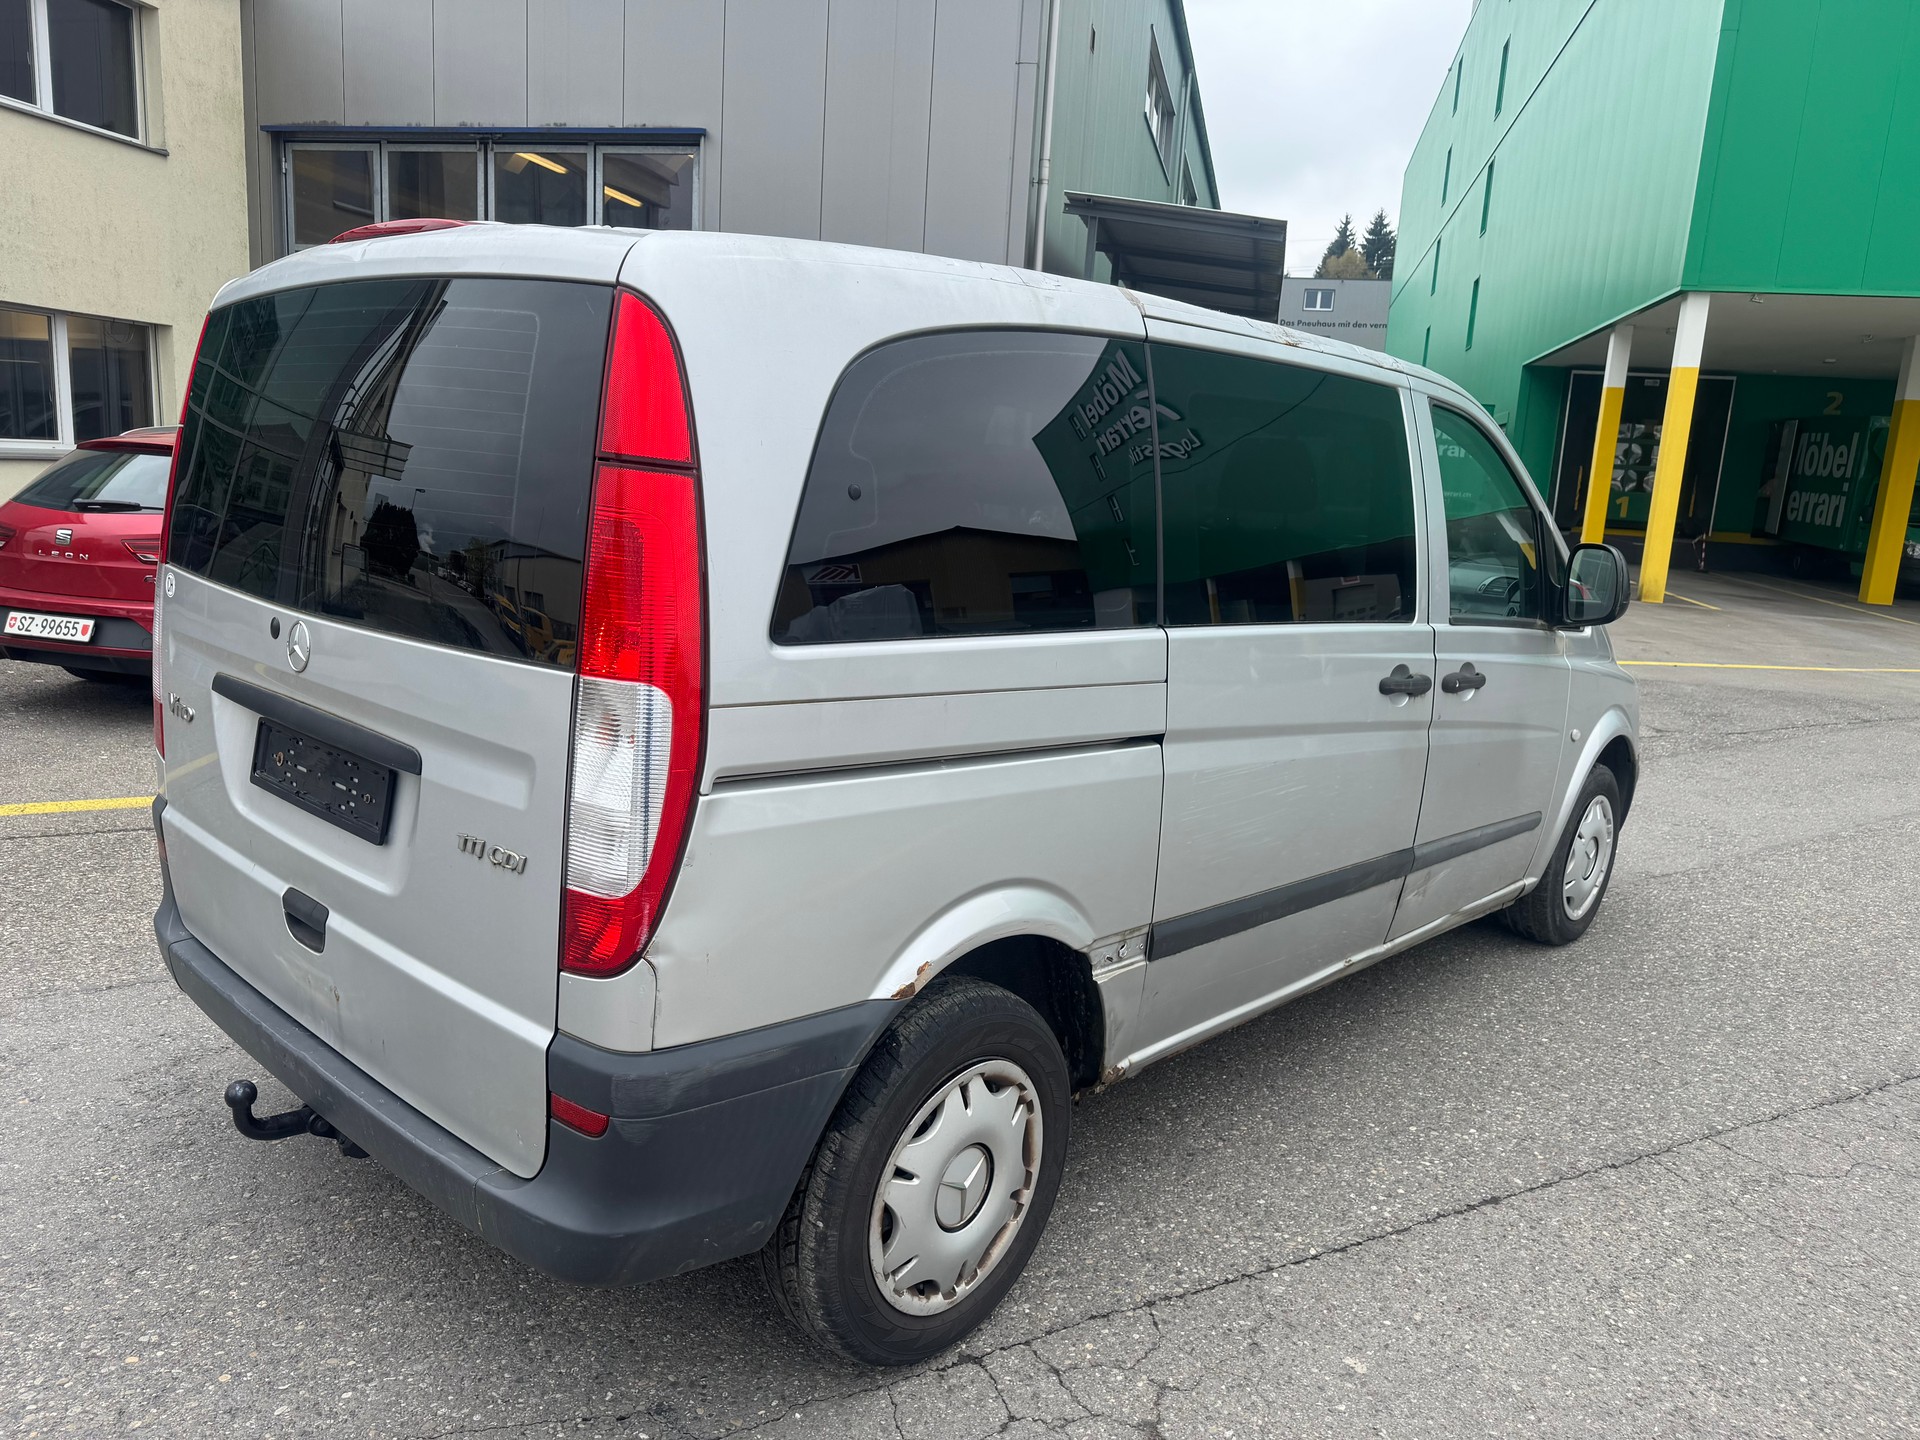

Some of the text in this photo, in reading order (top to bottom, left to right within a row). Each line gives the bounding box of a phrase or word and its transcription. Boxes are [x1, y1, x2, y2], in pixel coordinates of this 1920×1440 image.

[1279, 319, 1295, 327] Das
[1297, 319, 1336, 328] Pneuhaus
[1338, 320, 1350, 328] mit
[1352, 320, 1368, 328] den
[1823, 391, 1844, 415] 2
[1615, 496, 1630, 518] 1
[1786, 482, 1850, 528] errari
[38, 549, 89, 561] LEON
[168, 691, 196, 723] Vito
[487, 845, 528, 875] CDI
